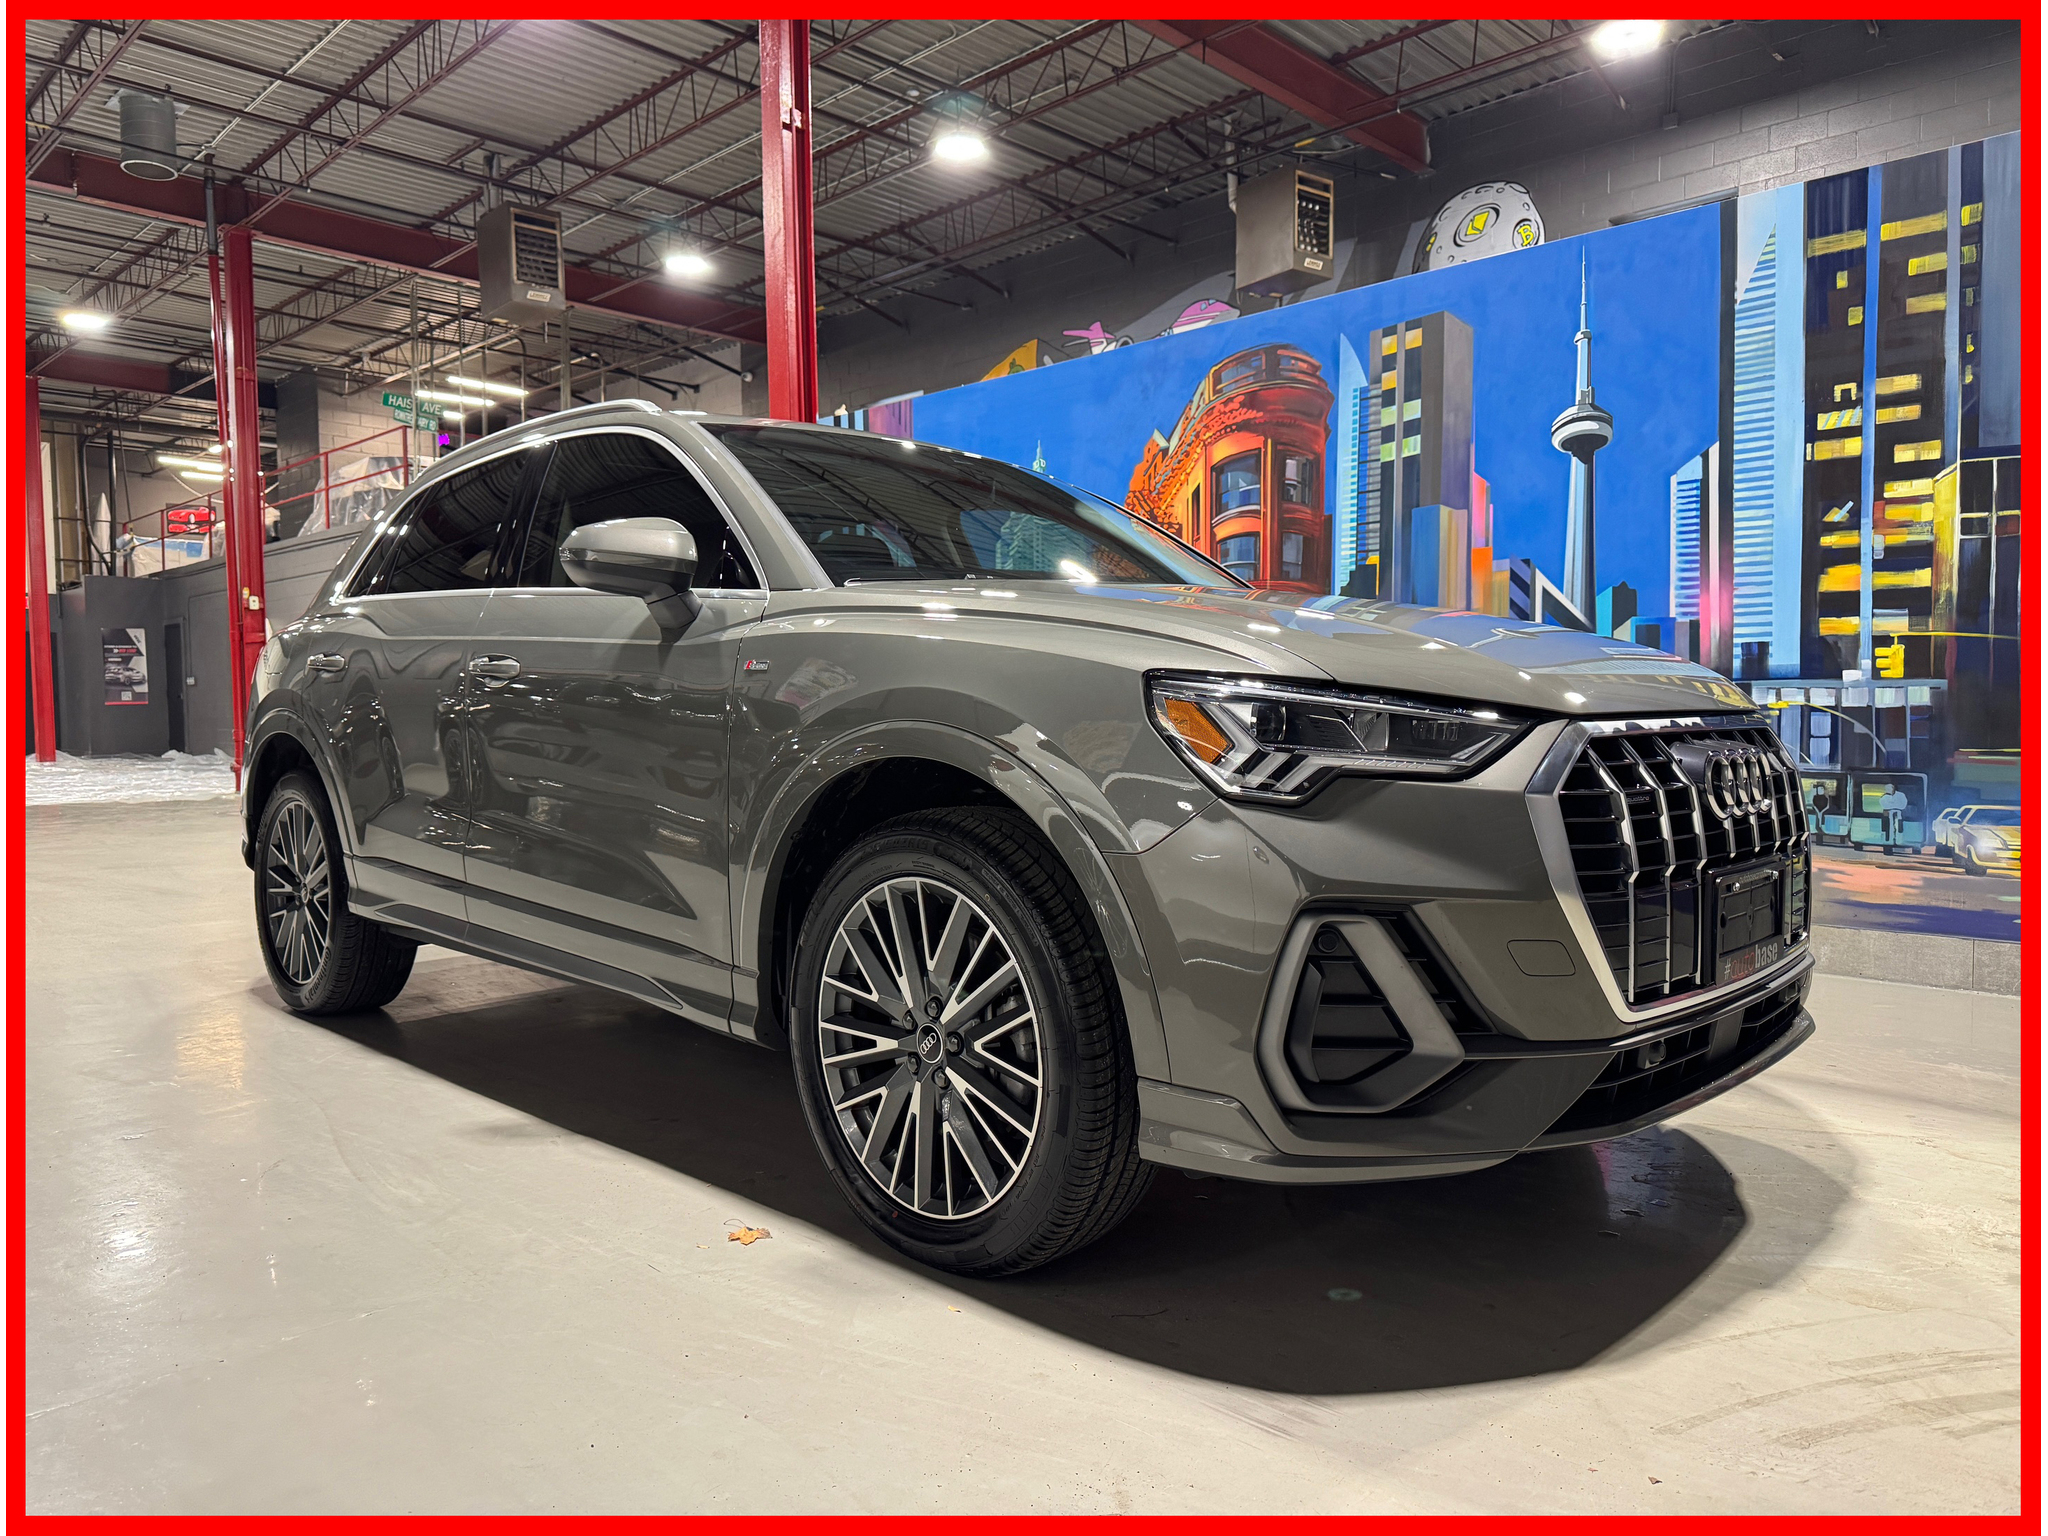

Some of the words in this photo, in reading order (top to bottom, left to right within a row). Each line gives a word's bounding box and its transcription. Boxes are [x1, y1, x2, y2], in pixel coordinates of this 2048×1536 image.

[388, 394, 414, 409] HAIS
[422, 402, 442, 415] AVE
[1724, 943, 1778, 981] #autobase
